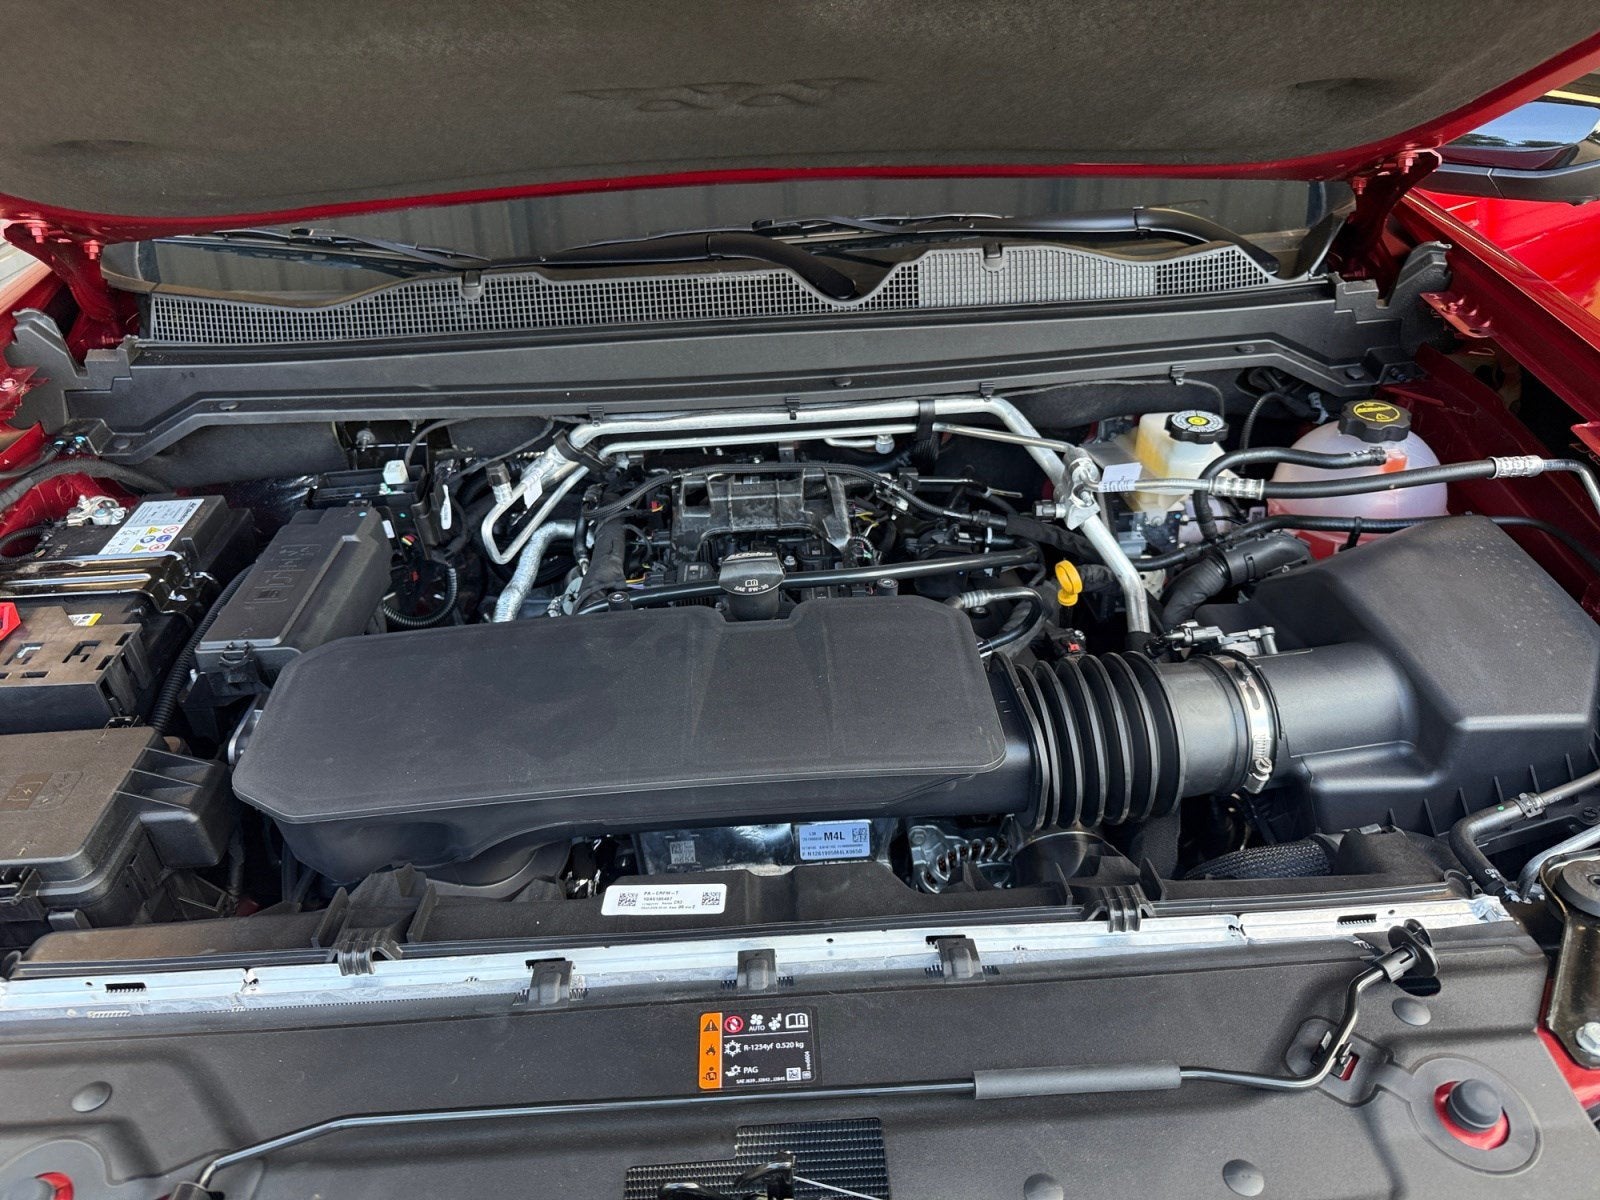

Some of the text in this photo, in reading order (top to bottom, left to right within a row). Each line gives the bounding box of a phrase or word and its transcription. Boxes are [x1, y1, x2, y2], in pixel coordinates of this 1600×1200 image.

[824, 832, 845, 840] M4L
[743, 1043, 774, 1051] R-1234yf
[795, 1041, 804, 1049] kg
[743, 1066, 759, 1074] PAG
